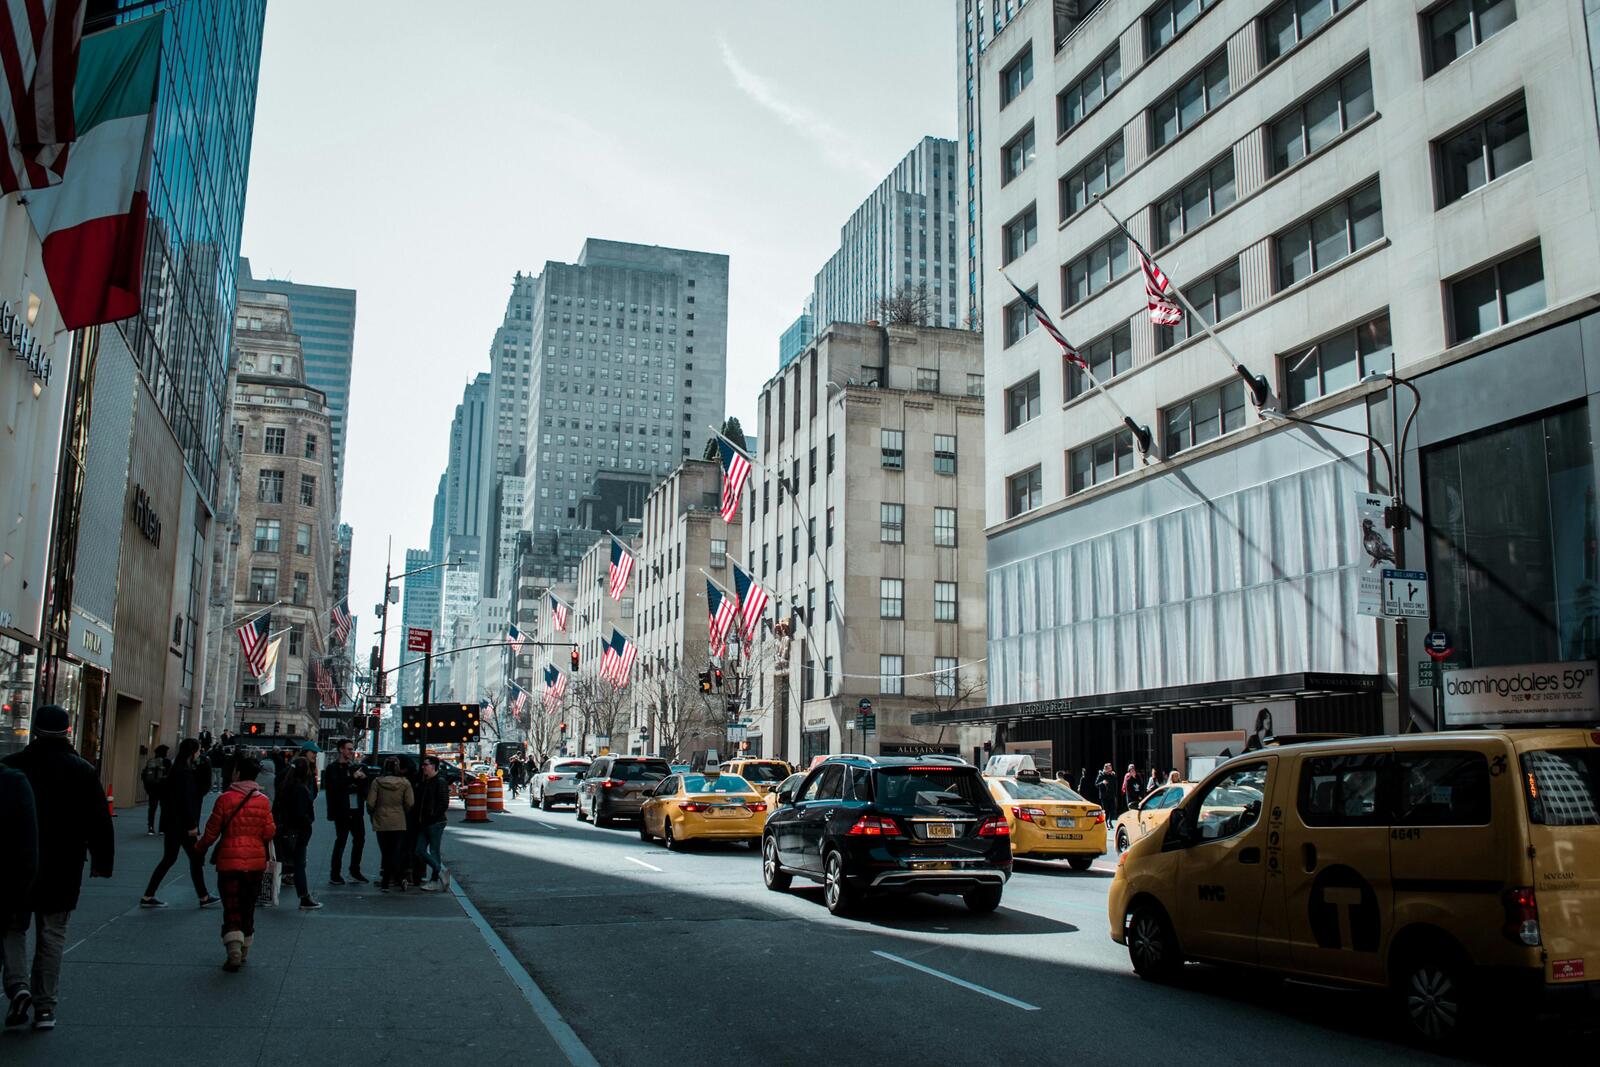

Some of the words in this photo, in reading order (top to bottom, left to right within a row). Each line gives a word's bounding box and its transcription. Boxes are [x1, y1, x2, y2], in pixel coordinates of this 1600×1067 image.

[1366, 498, 1381, 507] NYC
[1511, 694, 1524, 702] THE
[1532, 693, 1542, 701] OF
[1543, 692, 1560, 700] NEW
[1198, 884, 1225, 902] NYC
[1323, 887, 1362, 952] T
